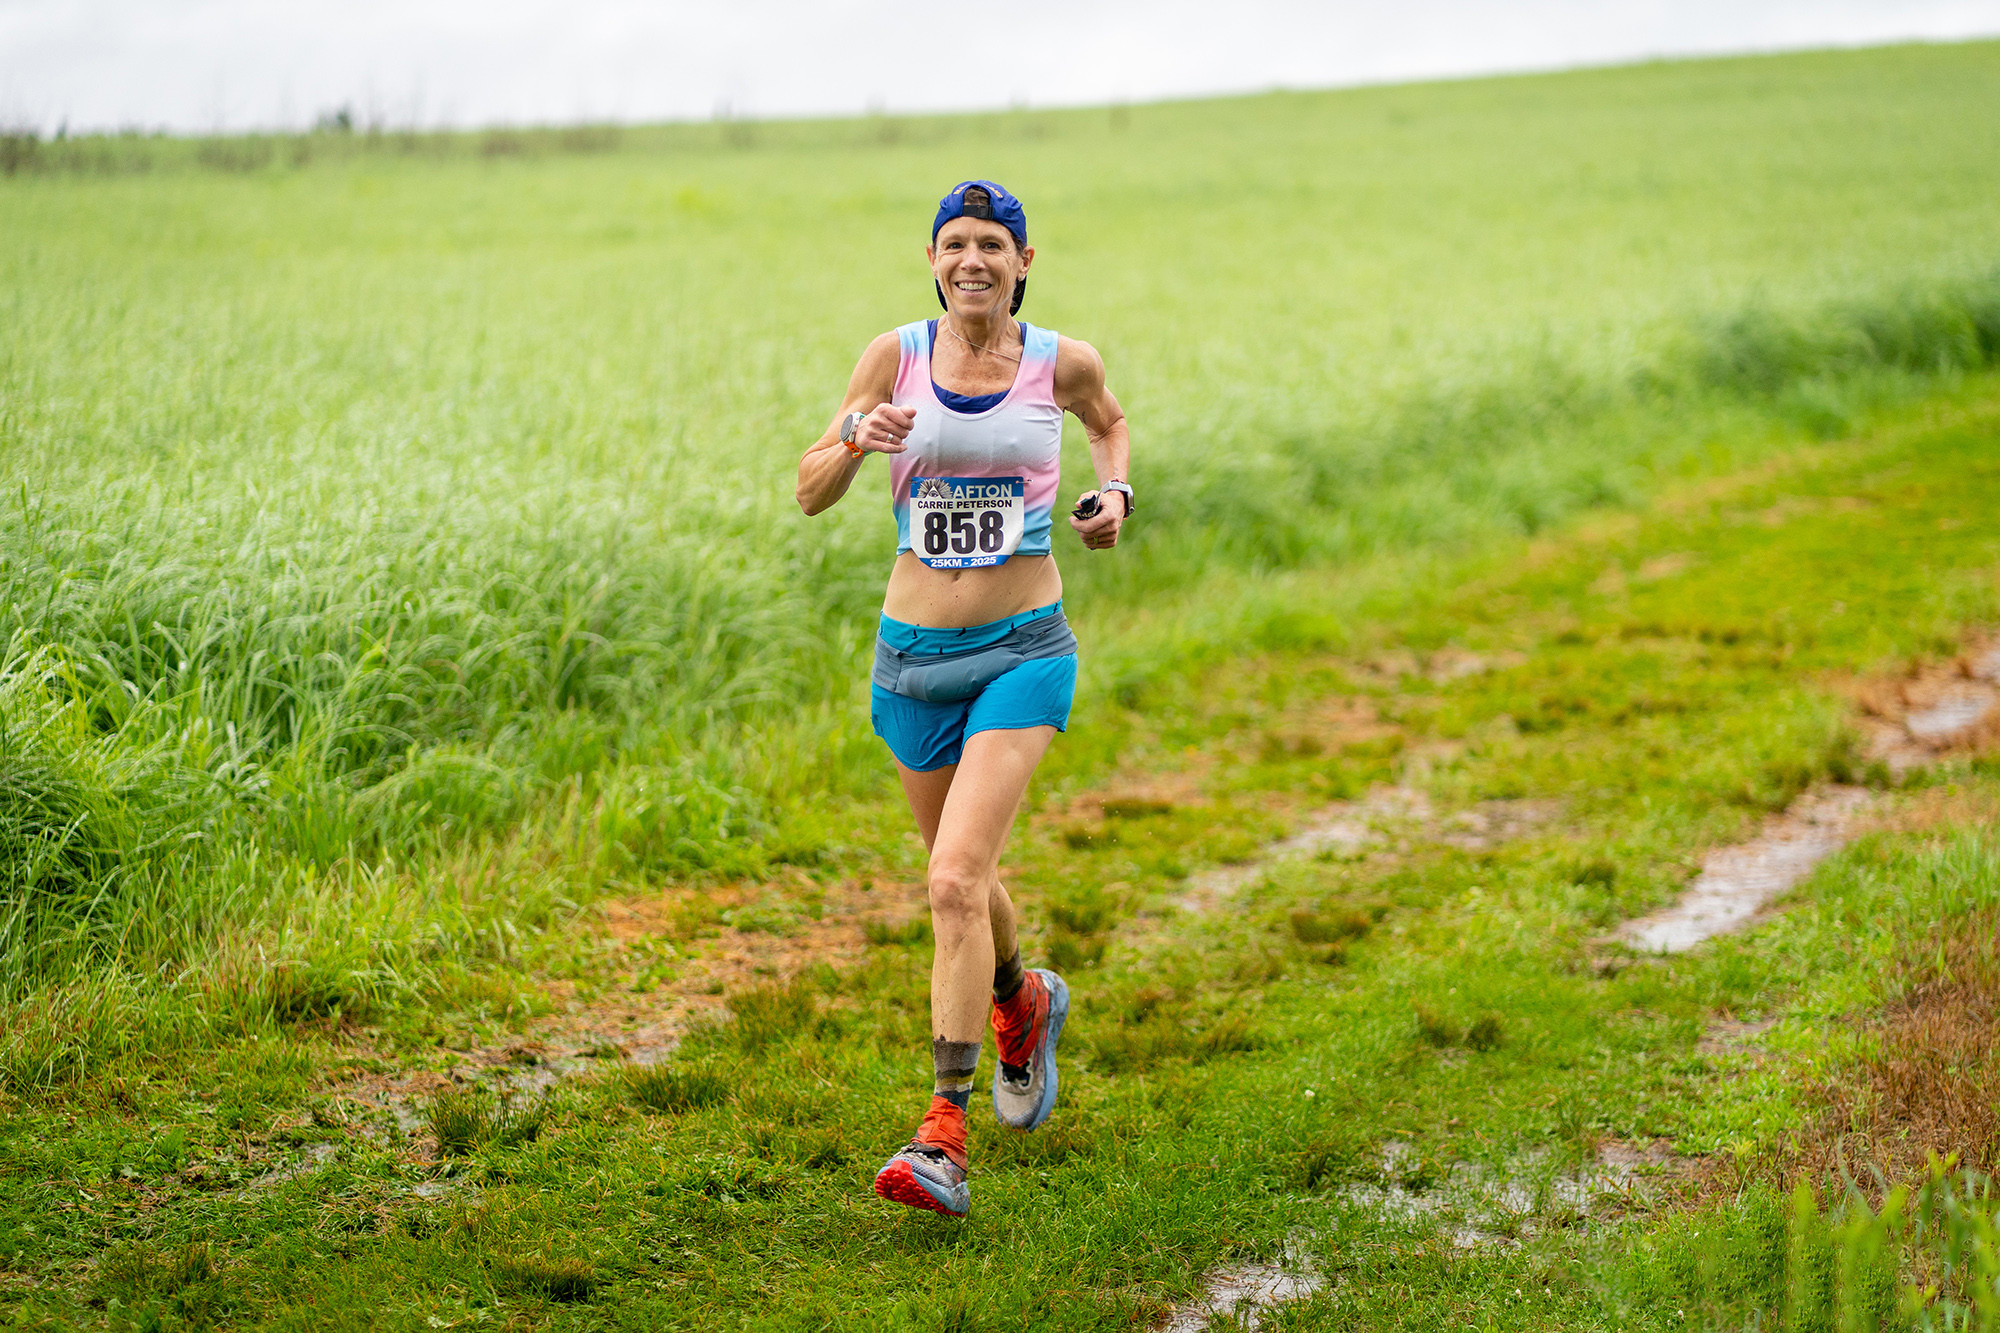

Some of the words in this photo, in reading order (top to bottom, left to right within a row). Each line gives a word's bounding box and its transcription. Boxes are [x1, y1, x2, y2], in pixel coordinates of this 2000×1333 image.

[953, 484, 1012, 498] AFTON
[917, 500, 954, 509] CARRIE
[956, 500, 1013, 509] PETERSON
[924, 510, 1004, 555] 858
[930, 558, 962, 567] 25KM
[970, 556, 997, 567] 2025
